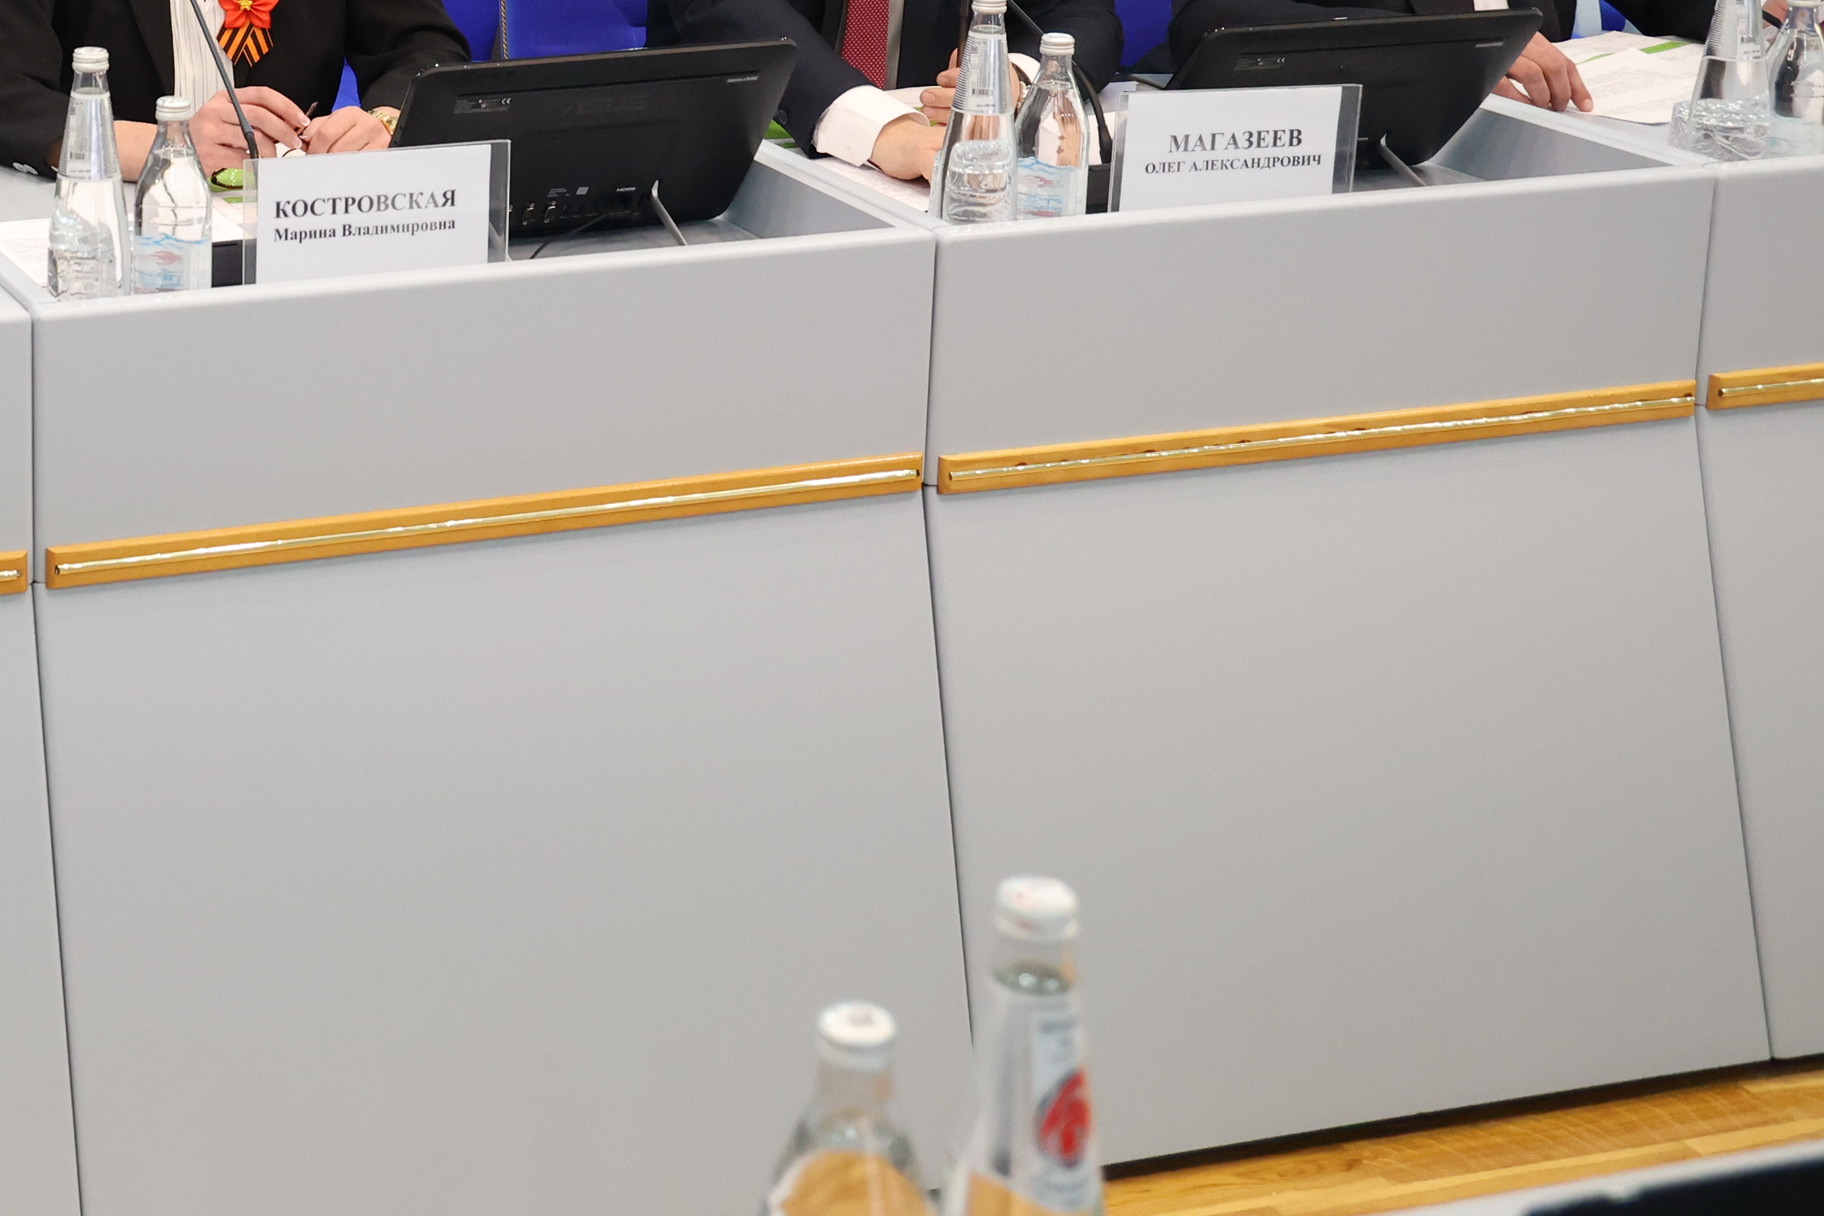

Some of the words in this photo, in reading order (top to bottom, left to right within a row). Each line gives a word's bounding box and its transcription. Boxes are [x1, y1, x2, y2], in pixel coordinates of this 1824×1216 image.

[1168, 128, 1303, 154] МАГАЗЕЕВ
[1144, 161, 1185, 175] ОЛЕГ
[1188, 154, 1322, 172] АЛЕКСАНДРОВИЧ
[274, 189, 457, 220] КОСТРОВСКАЯ
[273, 227, 337, 244] Марина
[341, 219, 456, 238] Владимировна
